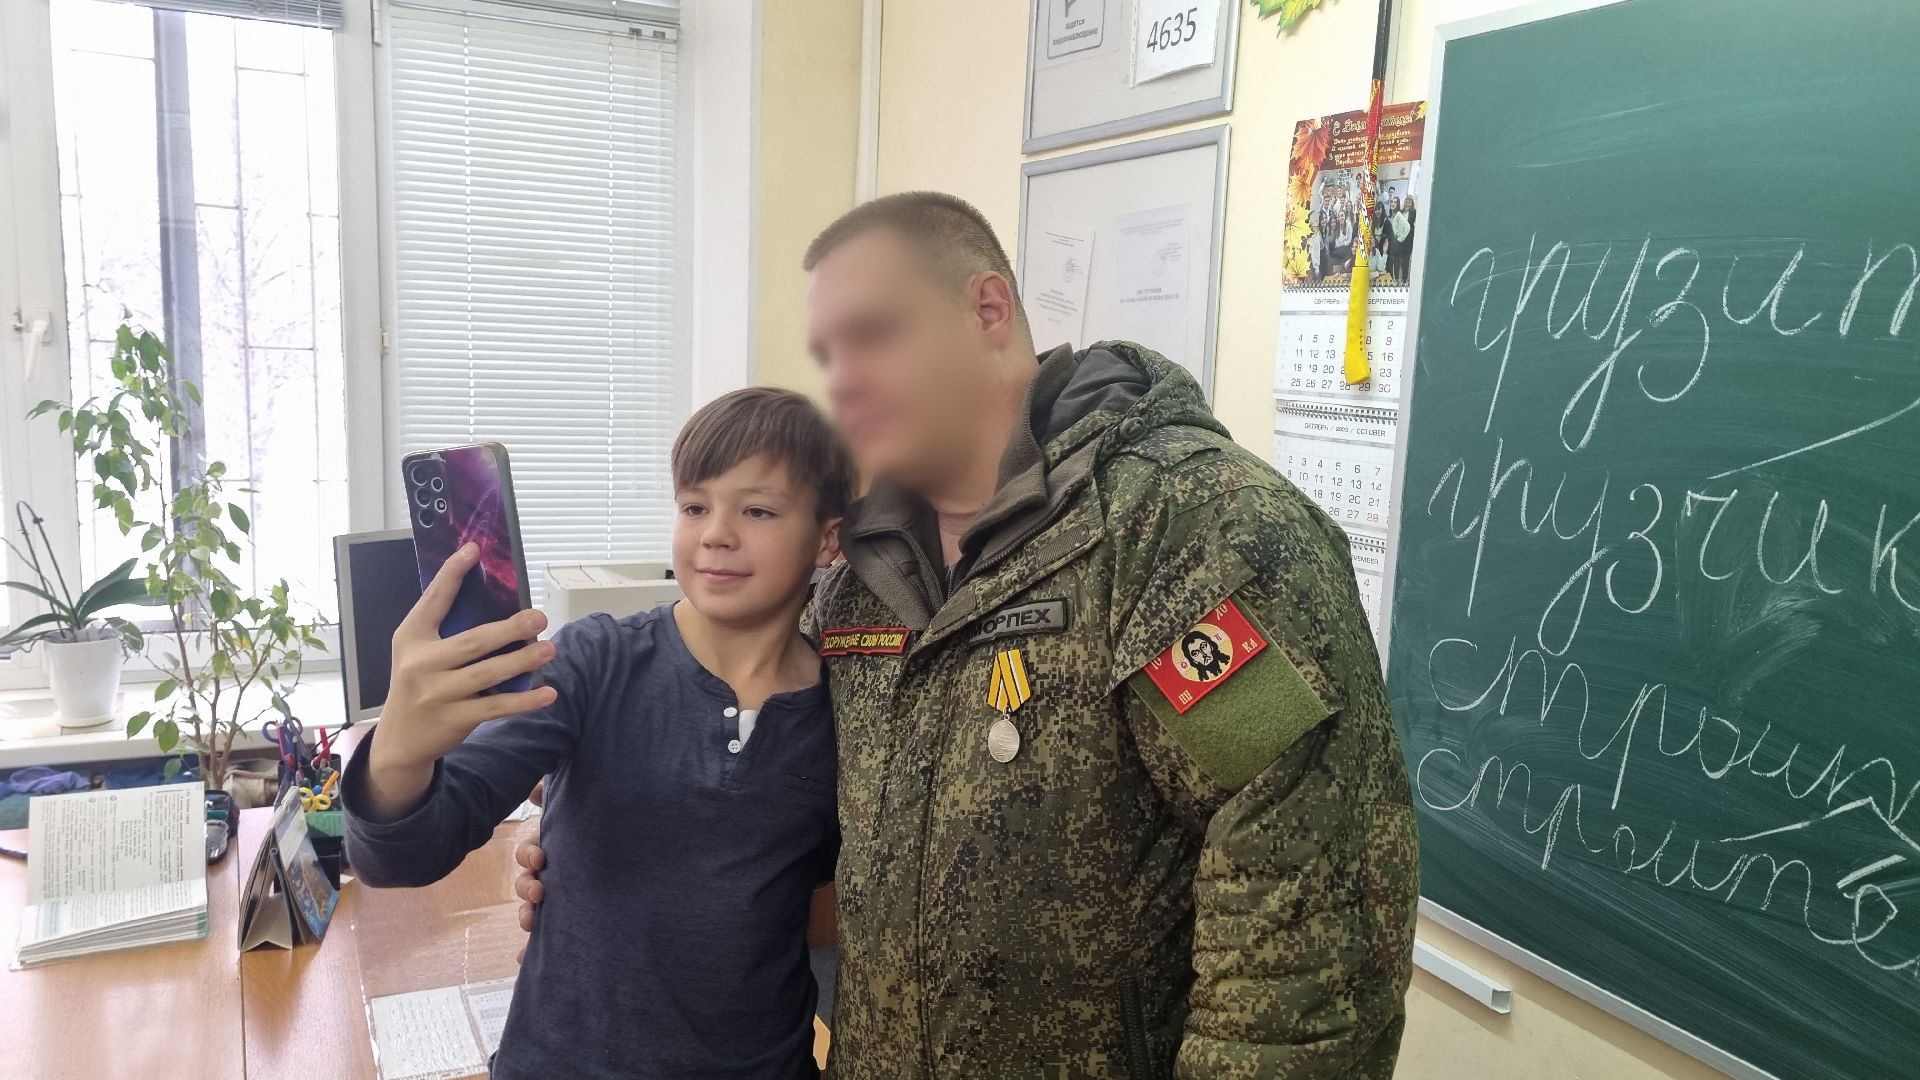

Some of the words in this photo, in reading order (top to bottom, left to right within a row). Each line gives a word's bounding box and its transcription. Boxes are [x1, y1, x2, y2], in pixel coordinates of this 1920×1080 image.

[1147, 8, 1197, 52] 4635
[1368, 320, 1372, 330] 1
[1387, 320, 1394, 330] 2
[1298, 333, 1303, 342] 4
[1312, 334, 1318, 343] 5
[1365, 336, 1372, 345] 8
[1385, 336, 1392, 346] 9
[1295, 349, 1303, 357] 11
[1310, 349, 1319, 359] 12
[1326, 349, 1336, 359] 13
[1382, 352, 1394, 362] 16
[1309, 364, 1318, 373] 19
[1323, 365, 1334, 374] 20
[1379, 368, 1392, 378] 23
[1291, 378, 1301, 387] 25
[1305, 379, 1316, 388] 26
[1321, 380, 1332, 389] 27
[1339, 381, 1351, 391] 28
[1358, 382, 1371, 391] 29
[1378, 384, 1391, 393] 30
[1356, 428, 1386, 437] OCTOBER
[1288, 455, 1293, 464] 2
[1301, 457, 1307, 467] 3
[1317, 460, 1323, 468] 4
[1335, 462, 1341, 471] 5
[1354, 464, 1361, 474] 6
[1375, 467, 1381, 476] 7
[1299, 471, 1308, 481] 10
[1315, 474, 1324, 484] 11
[1332, 476, 1343, 487] 12
[1350, 479, 1362, 489] 13
[1370, 482, 1382, 491] 14
[1313, 489, 1323, 499] 18
[1330, 491, 1341, 501] 19
[1348, 494, 1361, 504] 20
[1368, 497, 1380, 507] 21
[1328, 506, 1340, 516] 26
[1347, 509, 1359, 519] 27
[1366, 513, 1379, 523] 28
[1353, 555, 1379, 566] VEMBER
[1363, 578, 1370, 588] 4
[968, 608, 1052, 638] МОРПЕХ
